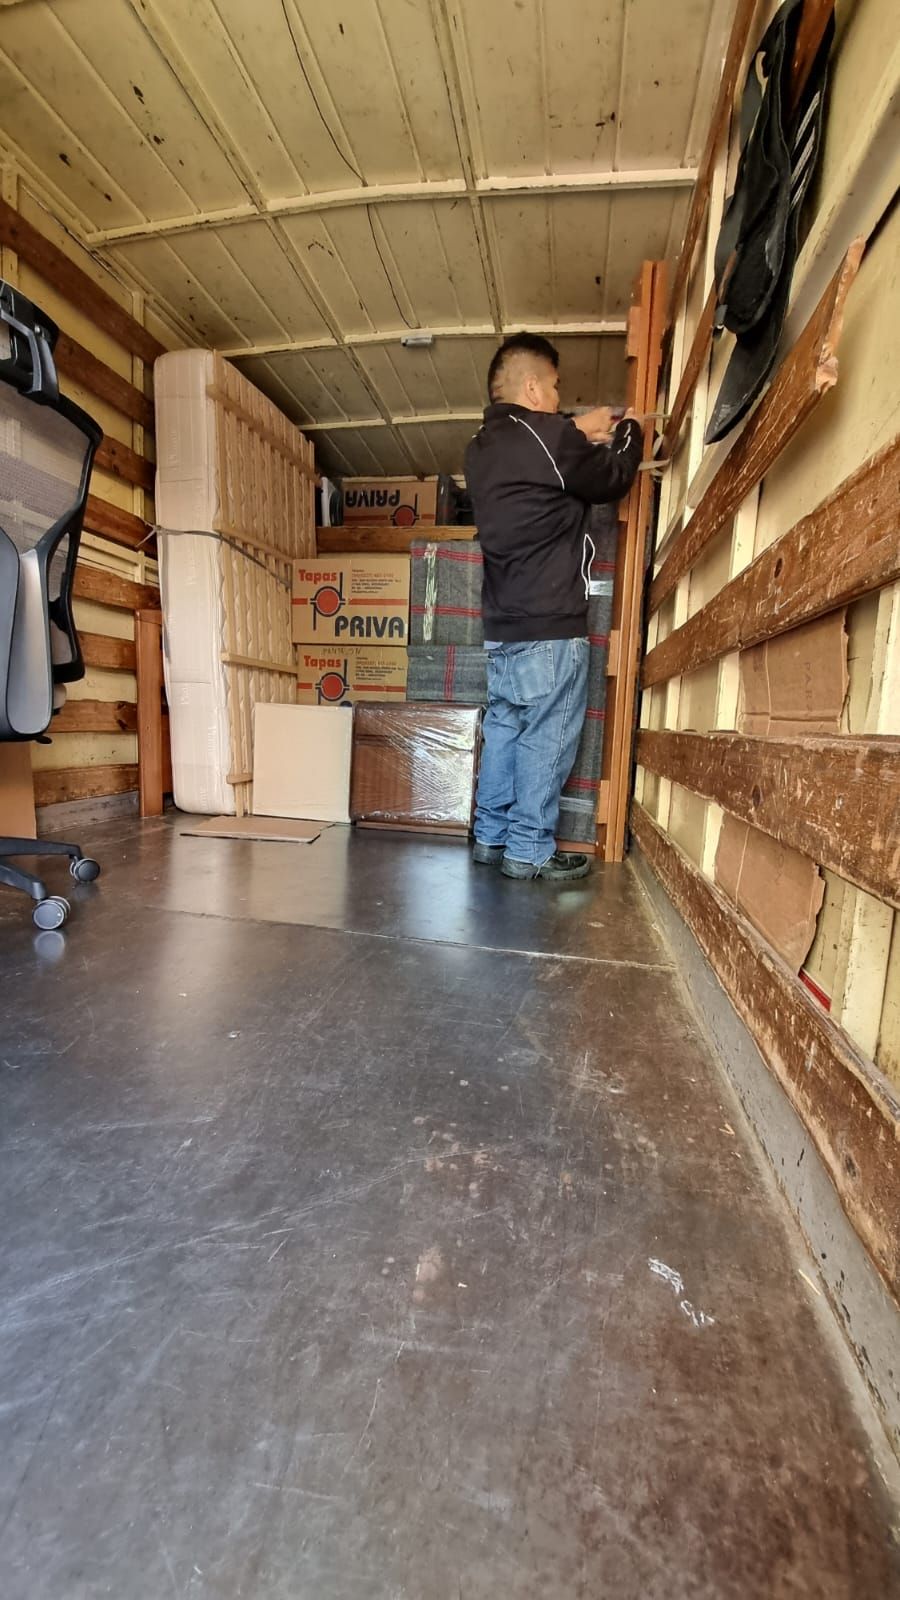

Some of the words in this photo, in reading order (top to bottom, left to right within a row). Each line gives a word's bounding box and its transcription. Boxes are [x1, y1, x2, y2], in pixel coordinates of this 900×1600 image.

[345, 489, 400, 507] PRIVA
[298, 569, 337, 584] Tapas
[335, 615, 404, 638] PRIVA
[304, 655, 342, 670] Tapas
